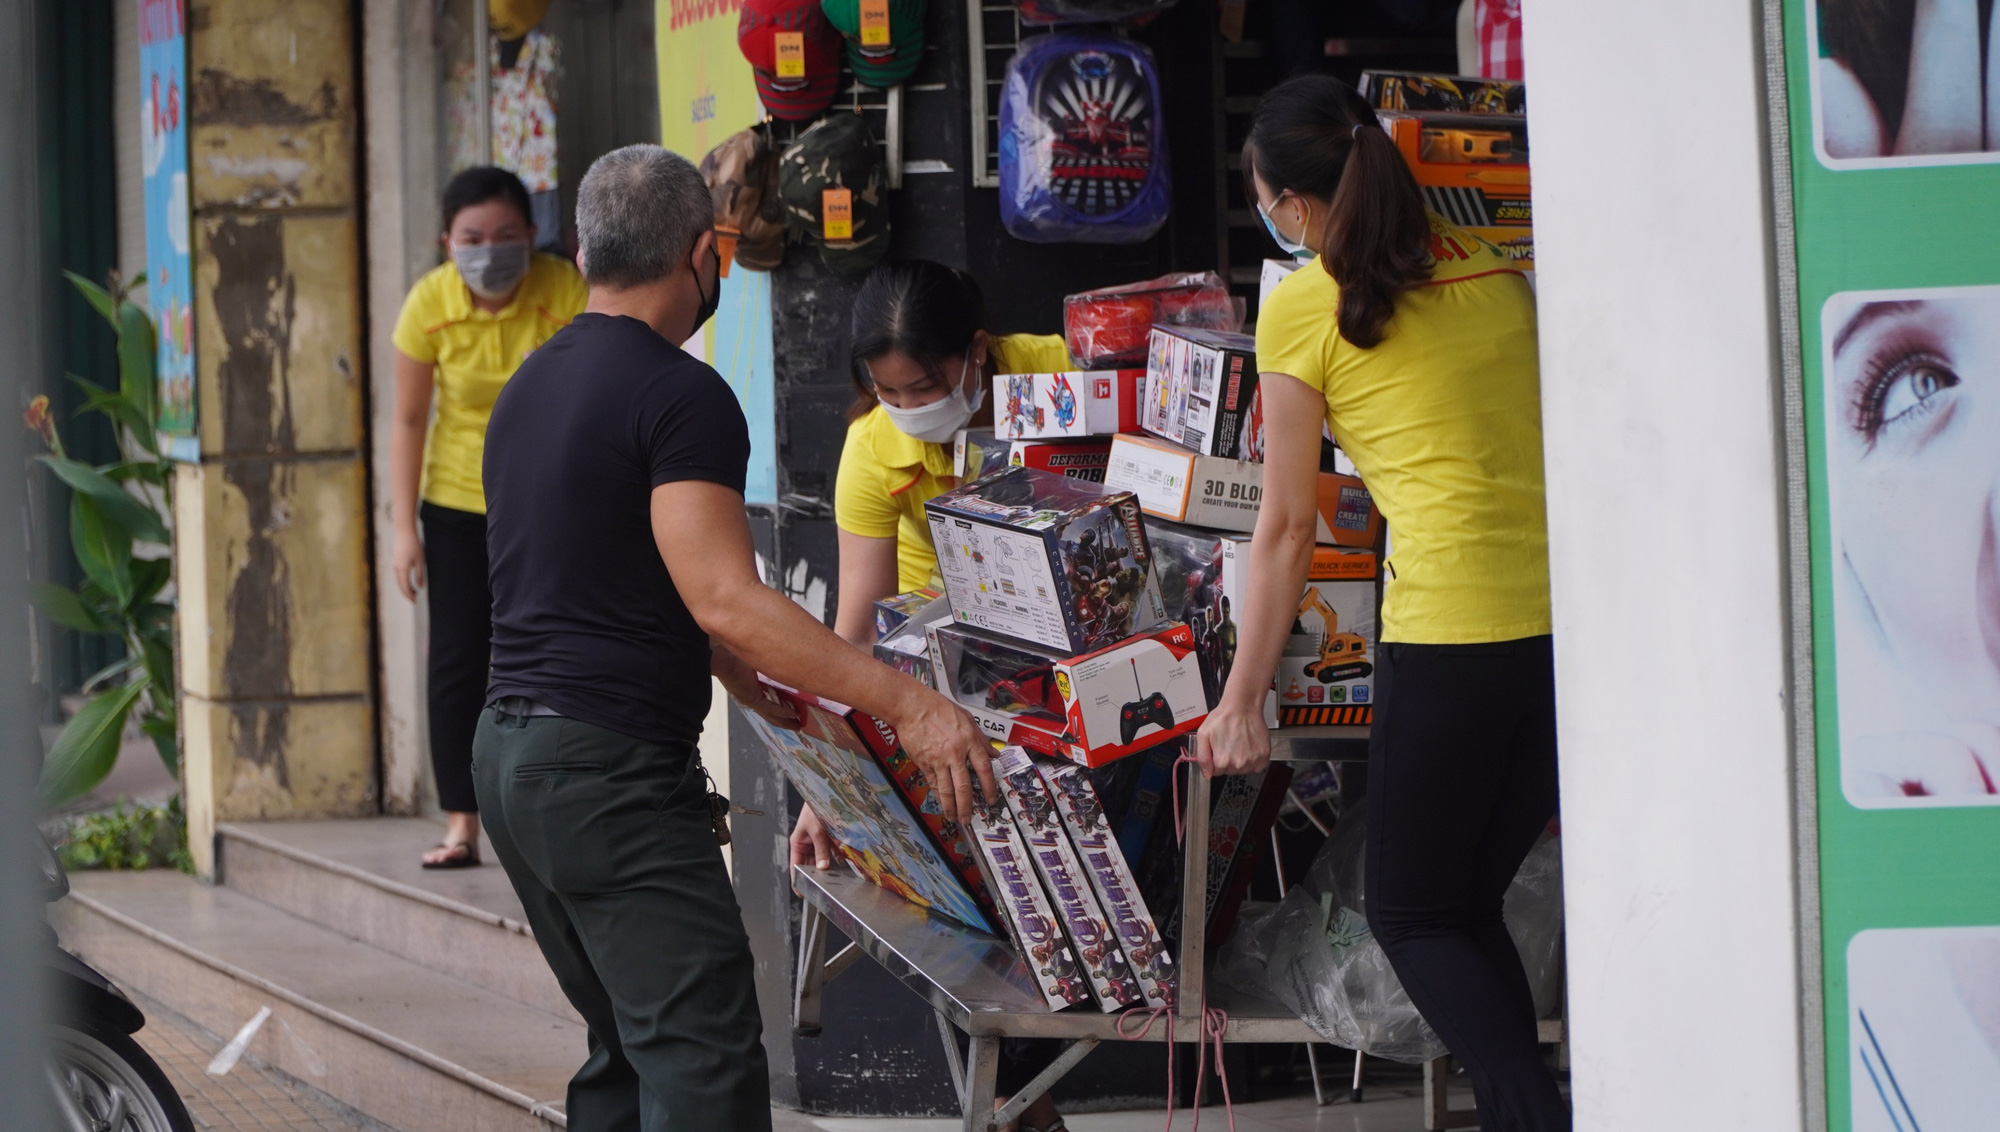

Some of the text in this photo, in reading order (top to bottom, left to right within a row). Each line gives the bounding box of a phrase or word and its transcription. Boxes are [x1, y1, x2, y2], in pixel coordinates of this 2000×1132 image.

[1496, 207, 1532, 218] ERIES
[1047, 454, 1108, 467] DEFORMA
[1065, 467, 1106, 483] ROB
[1204, 479, 1224, 497] 3D
[1342, 488, 1370, 499] BUILD
[1202, 498, 1223, 507] CREATE
[1338, 511, 1368, 522] CREATE
[1341, 562, 1371, 570] SERIES
[1052, 550, 1077, 637] CHALLENGE
[1172, 632, 1188, 645] RC
[871, 716, 896, 746] NJA
[984, 719, 1006, 734] CAR
